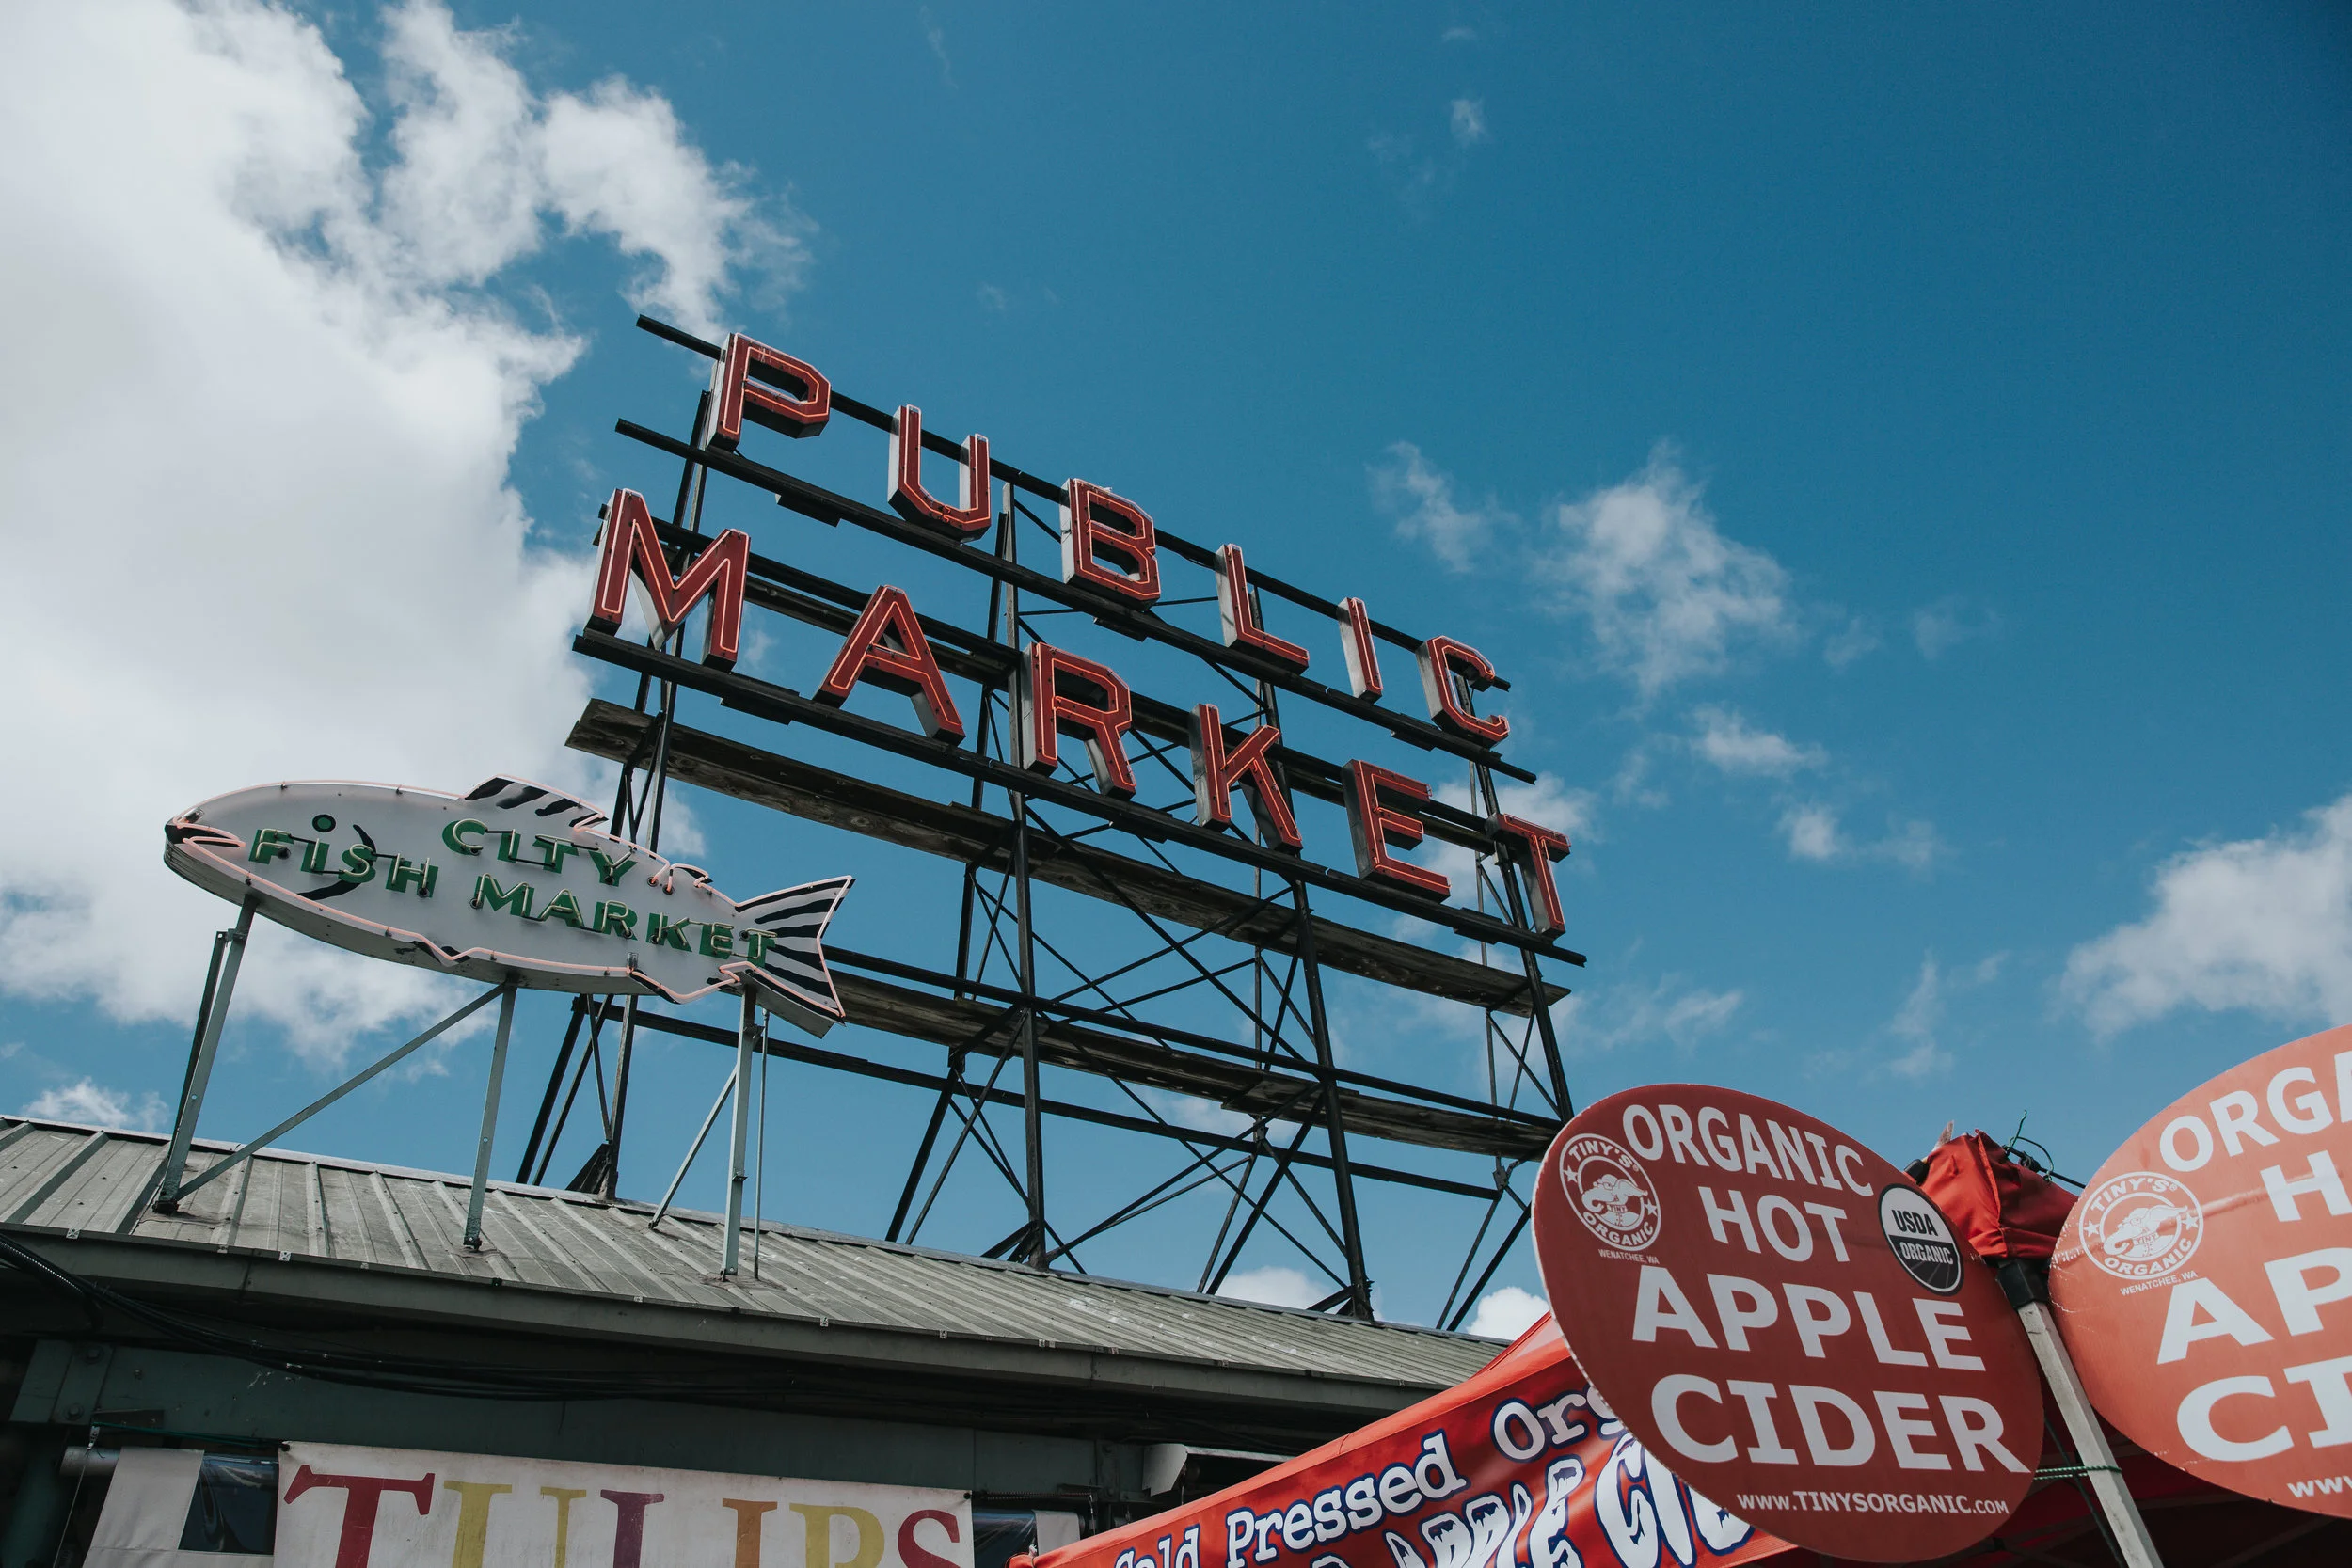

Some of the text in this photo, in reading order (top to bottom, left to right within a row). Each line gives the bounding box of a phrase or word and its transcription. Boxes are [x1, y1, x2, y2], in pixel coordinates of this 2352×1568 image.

[707, 332, 1509, 749] PUBLIC
[583, 488, 1570, 940] MARKET
[248, 829, 777, 967] FISH MARKET
[442, 818, 638, 887] CITY
[1623, 1104, 1873, 1196] ORGANIC
[2159, 1050, 2352, 1173] ORG
[1582, 1212, 1654, 1246] ORGANIC
[1698, 1186, 1849, 1262] HOT
[1892, 1210, 1938, 1236] USDA
[2259, 1149, 2352, 1222] H
[1598, 1249, 1660, 1264] WENATCHEE, WA
[1899, 1242, 1954, 1265] ORGANIC
[2105, 1238, 2192, 1275] ORGANIC
[2120, 1270, 2198, 1296] WENATCHEE, WA
[1632, 1265, 1986, 1371] APPLE
[2156, 1246, 2352, 1365] AP
[1651, 1374, 2031, 1473] CIDER
[2176, 1354, 2352, 1463] CI
[1227, 1433, 1467, 1568] Pressed
